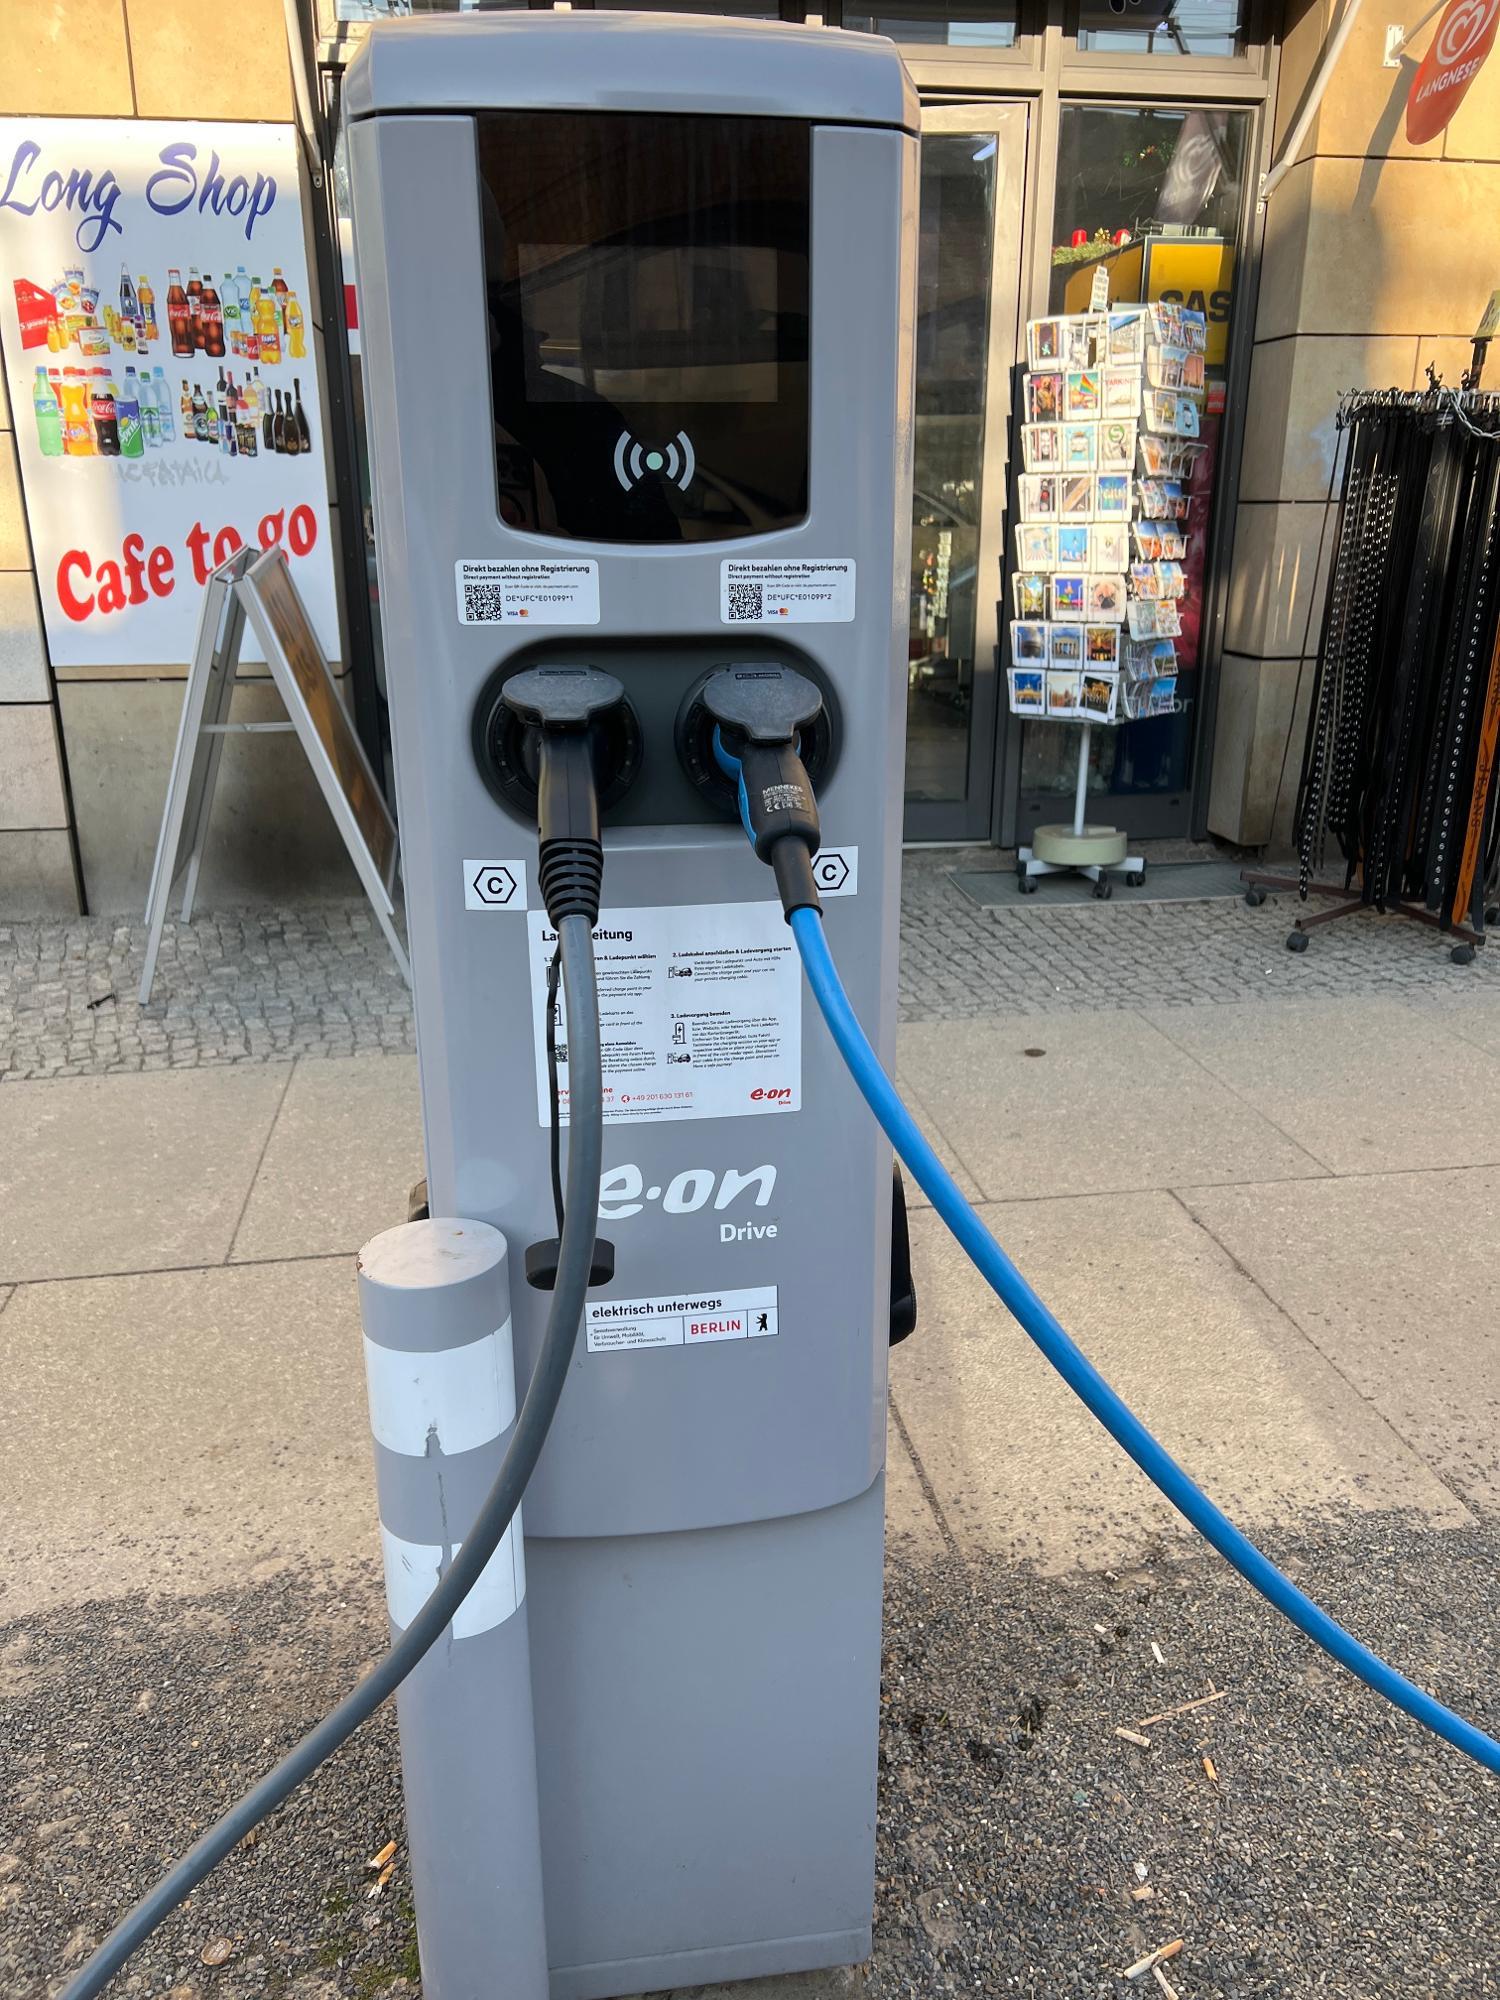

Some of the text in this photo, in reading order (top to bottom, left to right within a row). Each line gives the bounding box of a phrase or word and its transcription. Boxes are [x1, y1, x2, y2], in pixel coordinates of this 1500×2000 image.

[1416, 56, 1480, 104] LANGNESE
[0, 140, 277, 253] Long Shop
[56, 503, 318, 622] Cafe to go
[463, 564, 590, 574] Direkt bezahlen ohne Registrierung
[728, 564, 848, 573] Direkt bezahlen ohne Registrierung
[822, 864, 837, 881] C
[487, 877, 503, 894] C
[720, 1221, 778, 1243] Drive
[592, 1299, 723, 1318] elektrisch unterwegs
[690, 1320, 741, 1335] BERLIN
